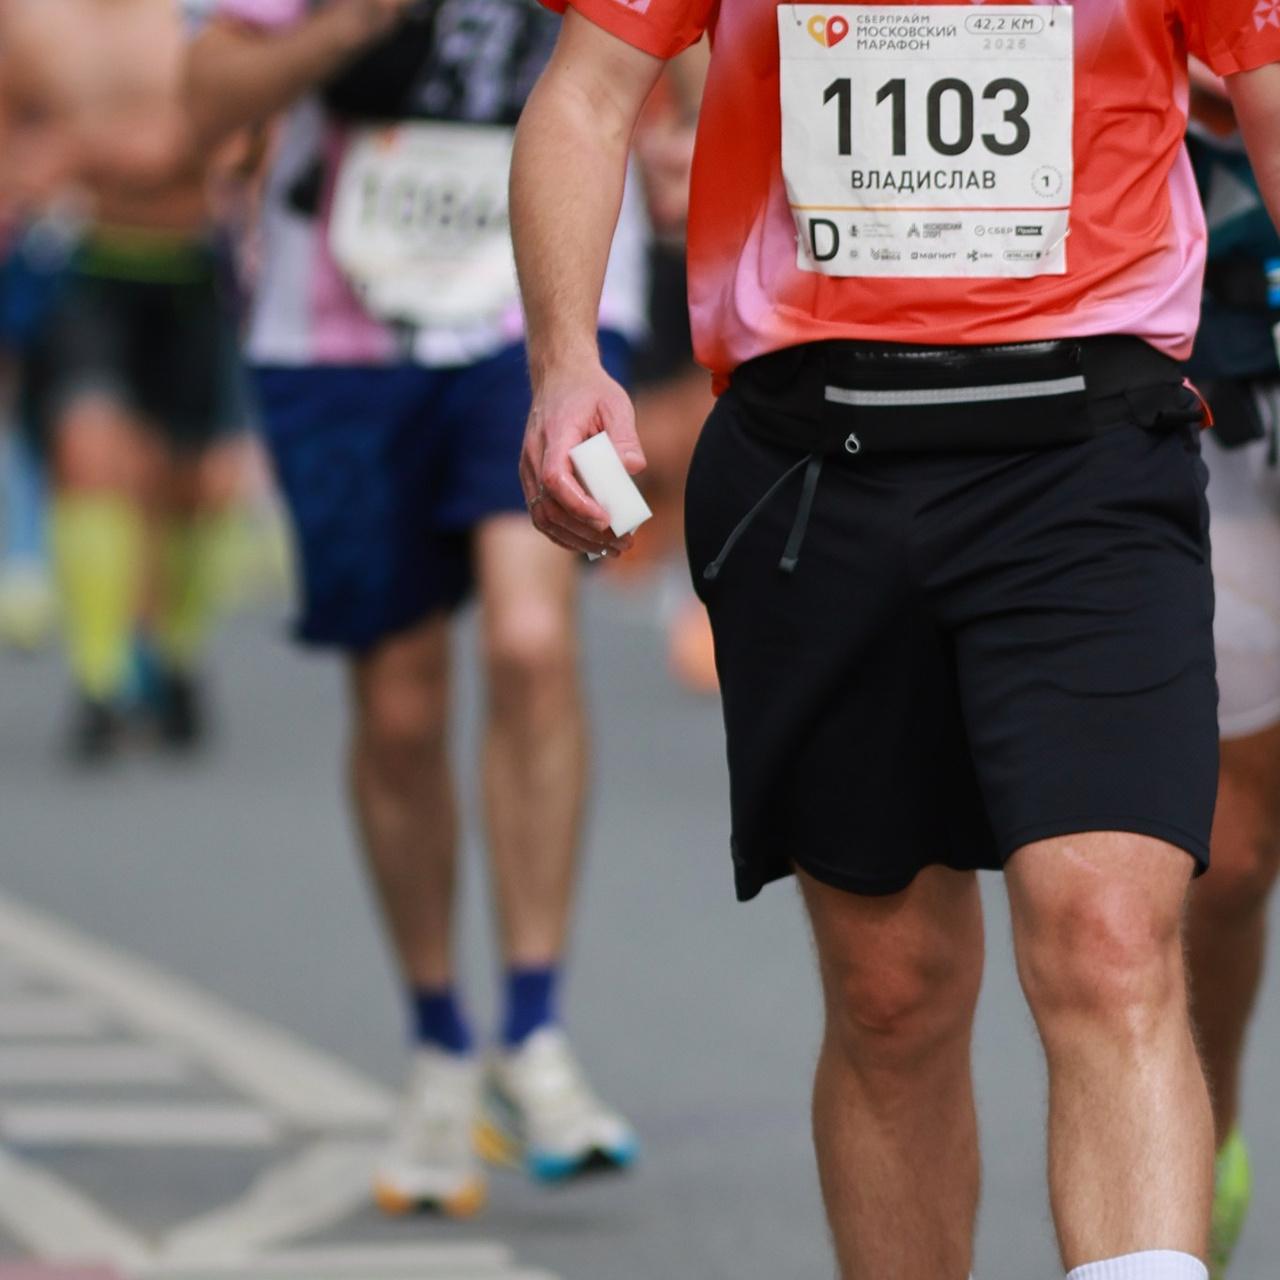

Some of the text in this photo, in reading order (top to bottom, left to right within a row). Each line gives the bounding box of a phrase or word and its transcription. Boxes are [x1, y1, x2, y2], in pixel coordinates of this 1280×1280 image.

[856, 14, 930, 24] СБЕРПРАЙМ
[973, 18, 1005, 31] 42,2
[856, 24, 957, 37] МОСКОВСКИЙ
[856, 39, 930, 51] МАРАФОН
[822, 77, 1031, 156] 1103
[851, 170, 996, 193] ВЛАДИСЛАВ
[1041, 175, 1049, 187] 1
[987, 227, 1013, 235] СБЕР
[809, 218, 839, 261] D
